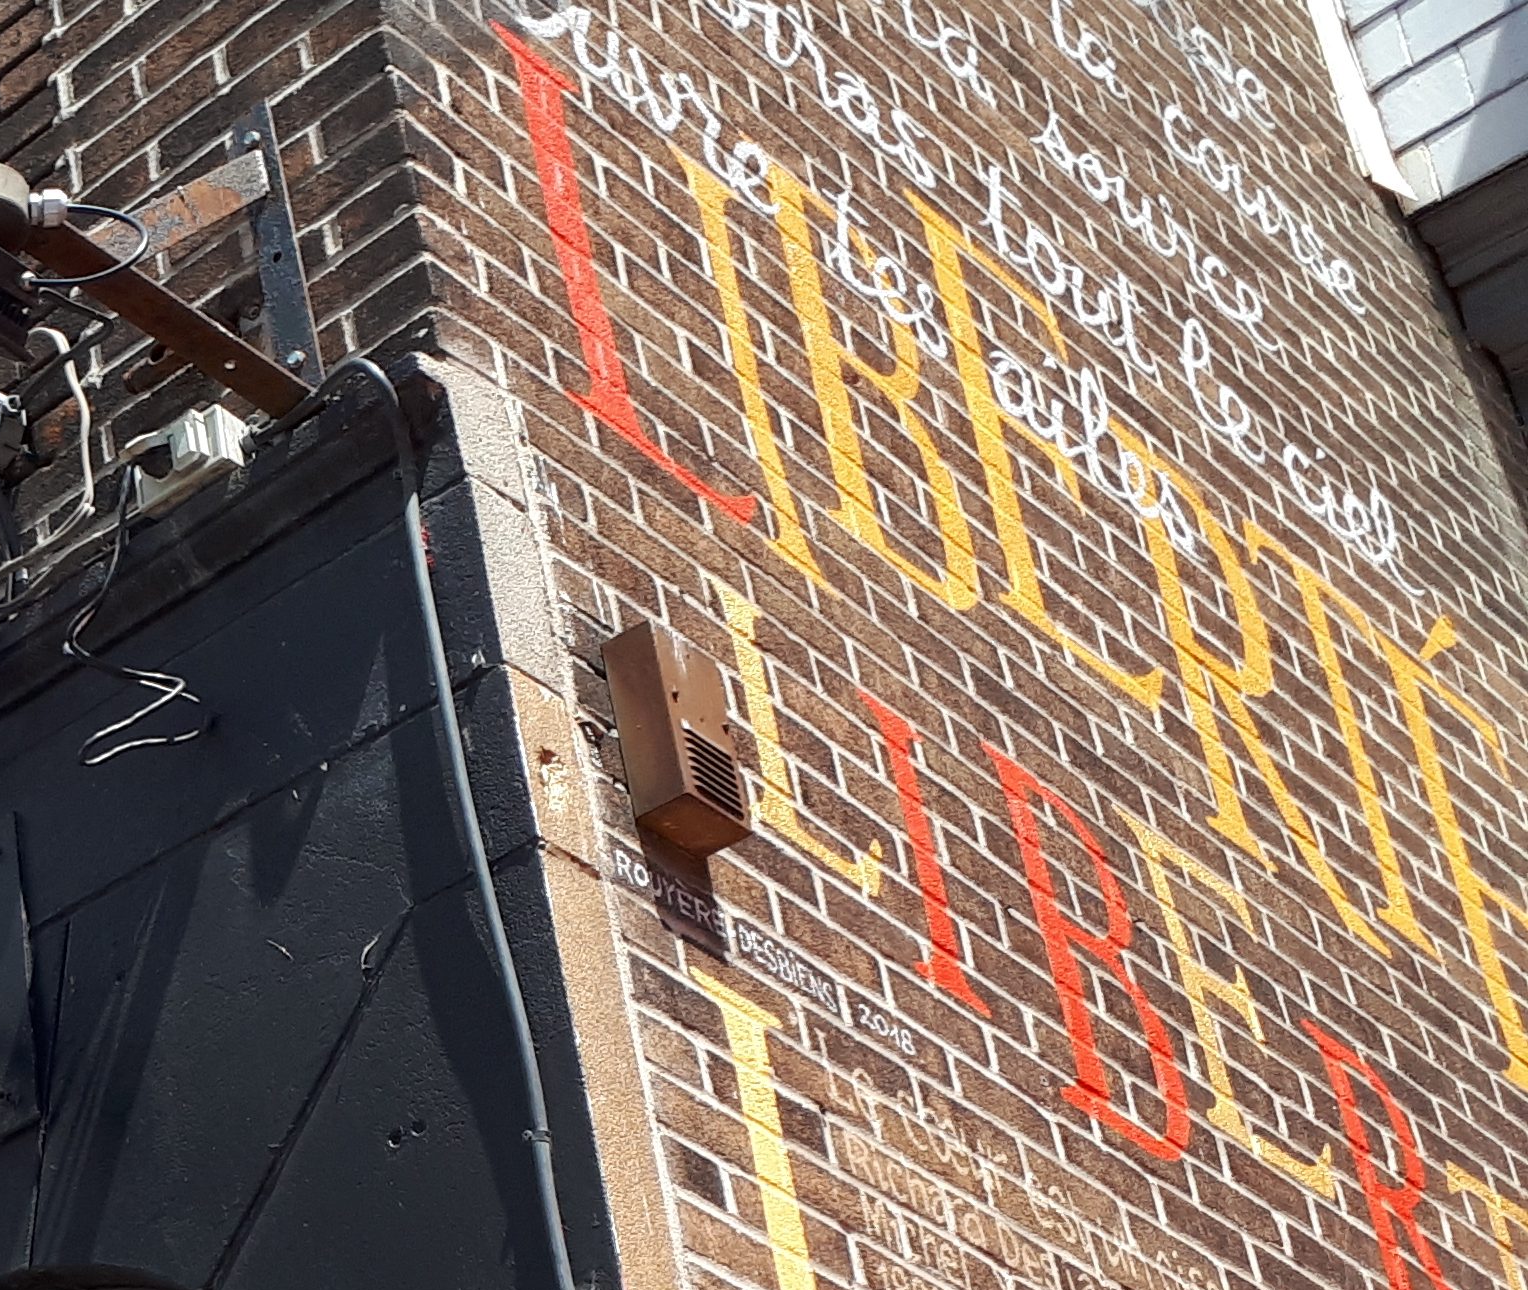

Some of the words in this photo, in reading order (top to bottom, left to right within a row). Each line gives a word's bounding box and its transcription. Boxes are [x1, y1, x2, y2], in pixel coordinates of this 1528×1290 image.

[1030, 112, 1280, 352] source
[1162, 104, 1365, 314] course
[820, 186, 948, 358] tes
[989, 351, 1198, 556] ailes
[980, 165, 1157, 374] tout
[1183, 318, 1267, 463] le
[1284, 444, 1425, 595] ciel
[857, 1003, 918, 1056] 2018
[844, 1130, 988, 1249] Richard
